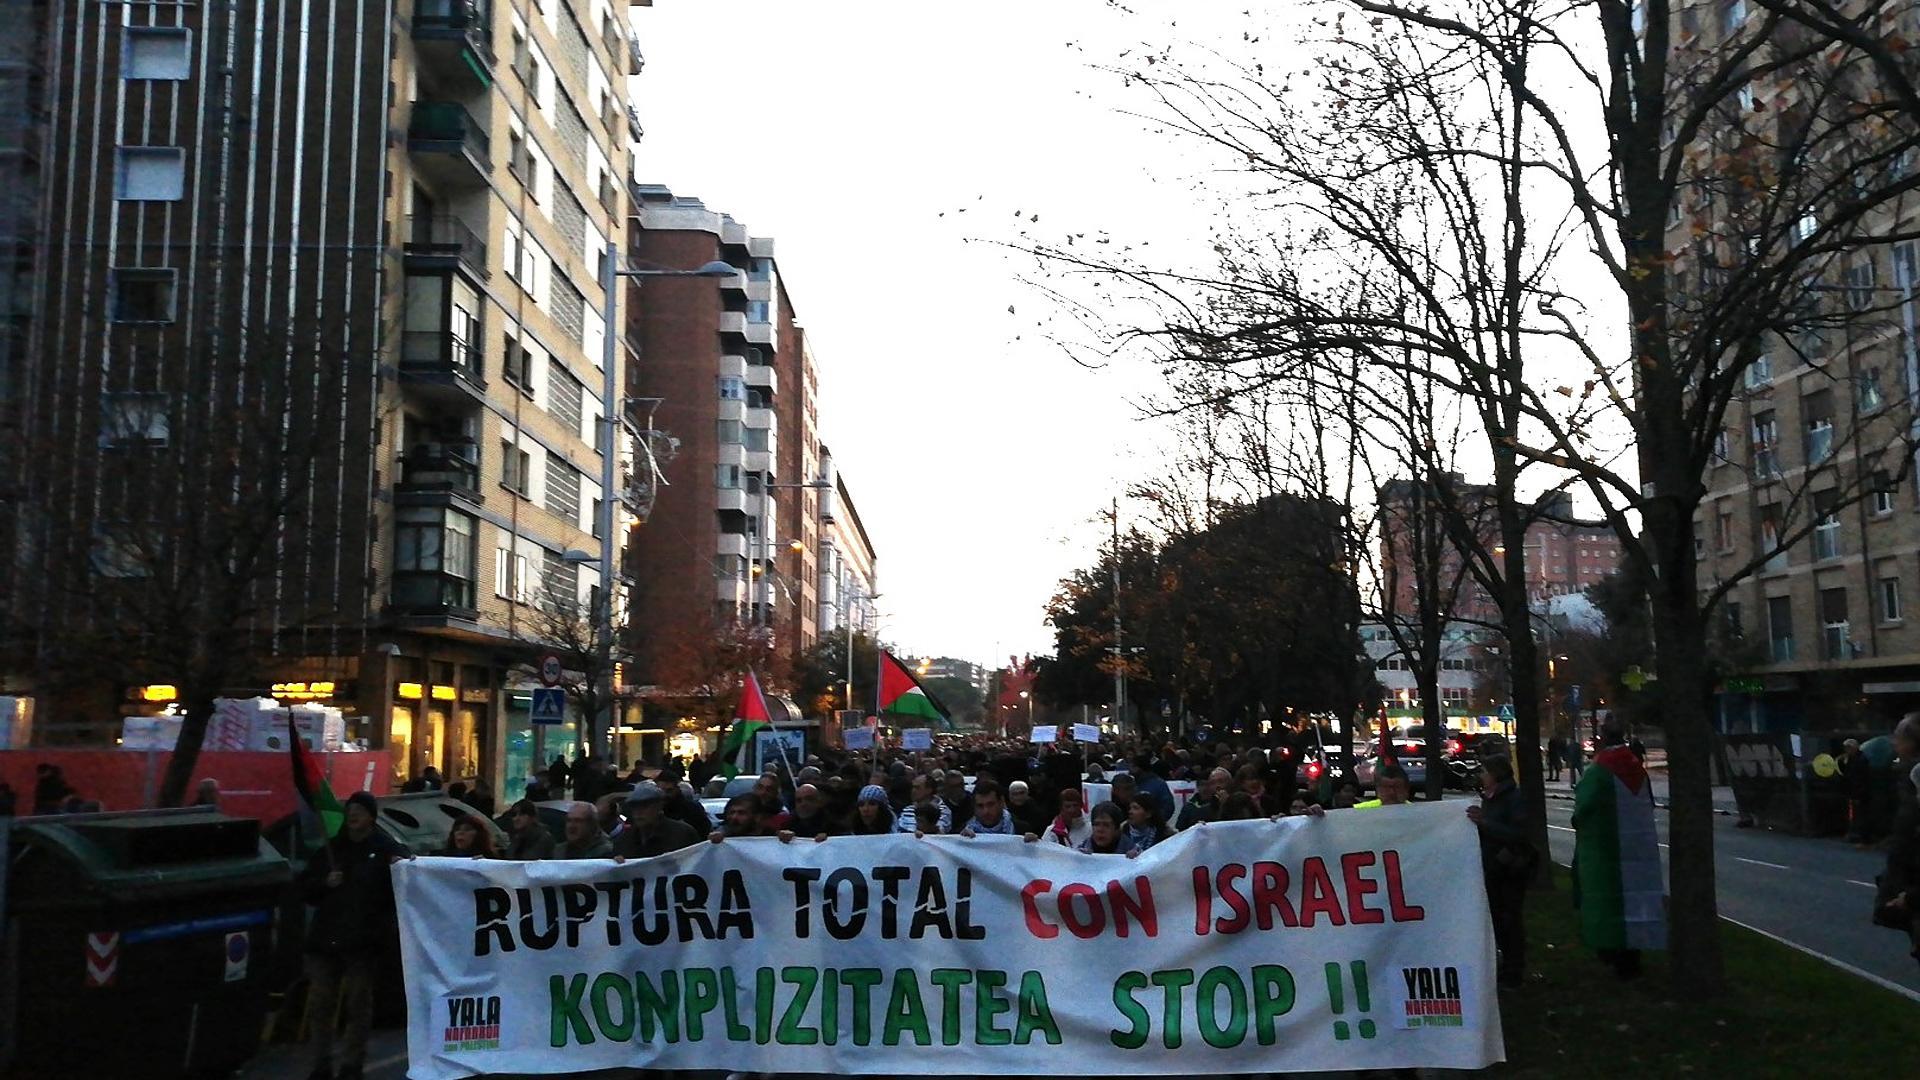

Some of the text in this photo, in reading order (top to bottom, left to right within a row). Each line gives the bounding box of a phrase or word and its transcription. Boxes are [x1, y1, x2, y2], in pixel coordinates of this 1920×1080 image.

[474, 850, 1425, 956] RUPTURA TOTAL CON ISRAEL
[447, 996, 501, 1027] YALA
[549, 966, 1062, 1048] KONPLIZITATEA
[1110, 964, 1296, 1049] STOP
[1402, 967, 1460, 1000] YALA
